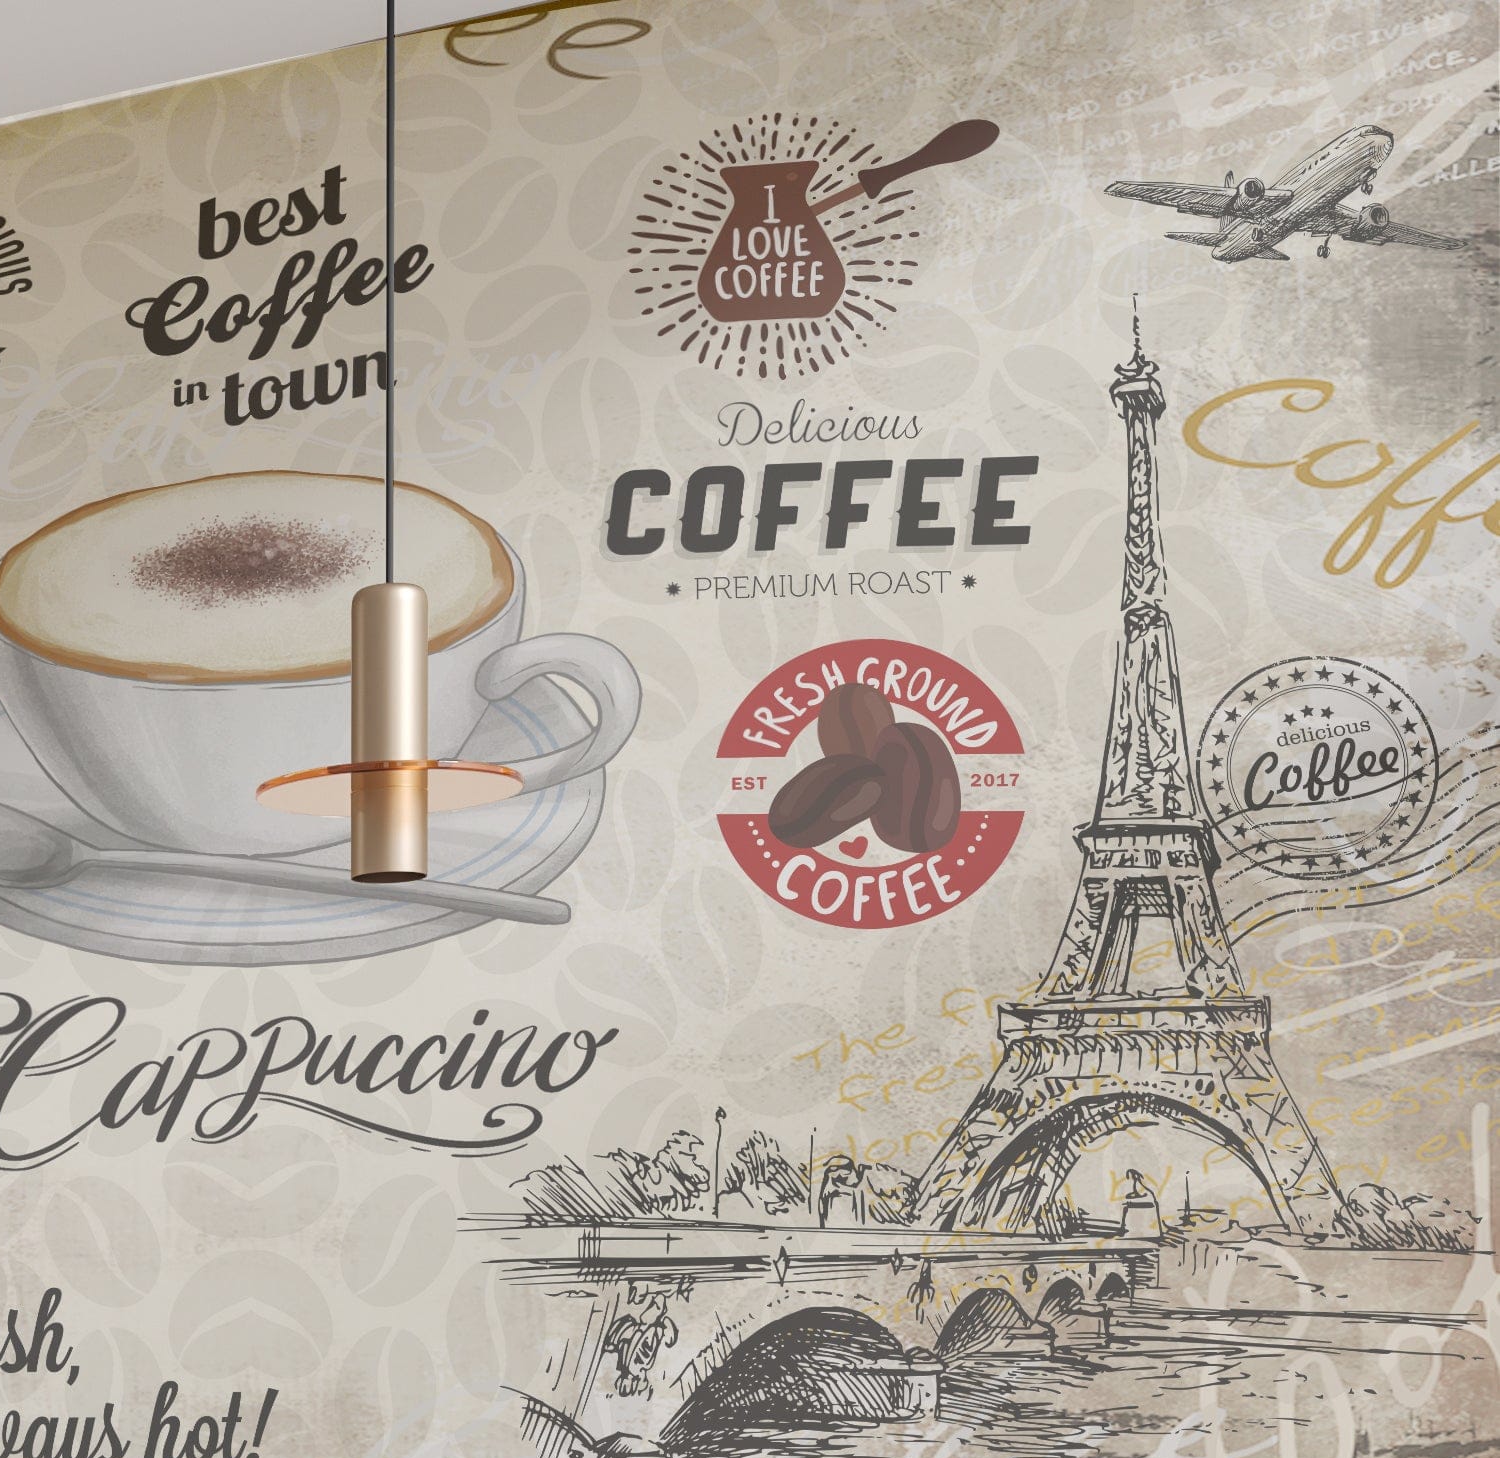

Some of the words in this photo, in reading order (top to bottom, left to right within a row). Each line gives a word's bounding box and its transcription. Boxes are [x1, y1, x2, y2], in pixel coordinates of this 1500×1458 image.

[198, 164, 348, 260] best
[763, 184, 781, 224] I
[732, 224, 811, 261] LOVE
[125, 238, 434, 361] Coffee
[715, 261, 824, 300] COFFEE
[173, 379, 209, 407] in
[222, 351, 397, 427] town
[717, 398, 923, 447] Delicious
[603, 455, 1040, 557] COFFEE
[693, 573, 838, 601] PREMIUM
[849, 570, 952, 597] ROAST
[742, 659, 846, 750] FRESH
[856, 656, 998, 748] GROUND
[1276, 719, 1371, 747] delicious
[730, 776, 767, 791] EST
[970, 773, 1020, 788] 2017
[1243, 737, 1400, 811] Coffee
[776, 854, 961, 922] COFFEE
